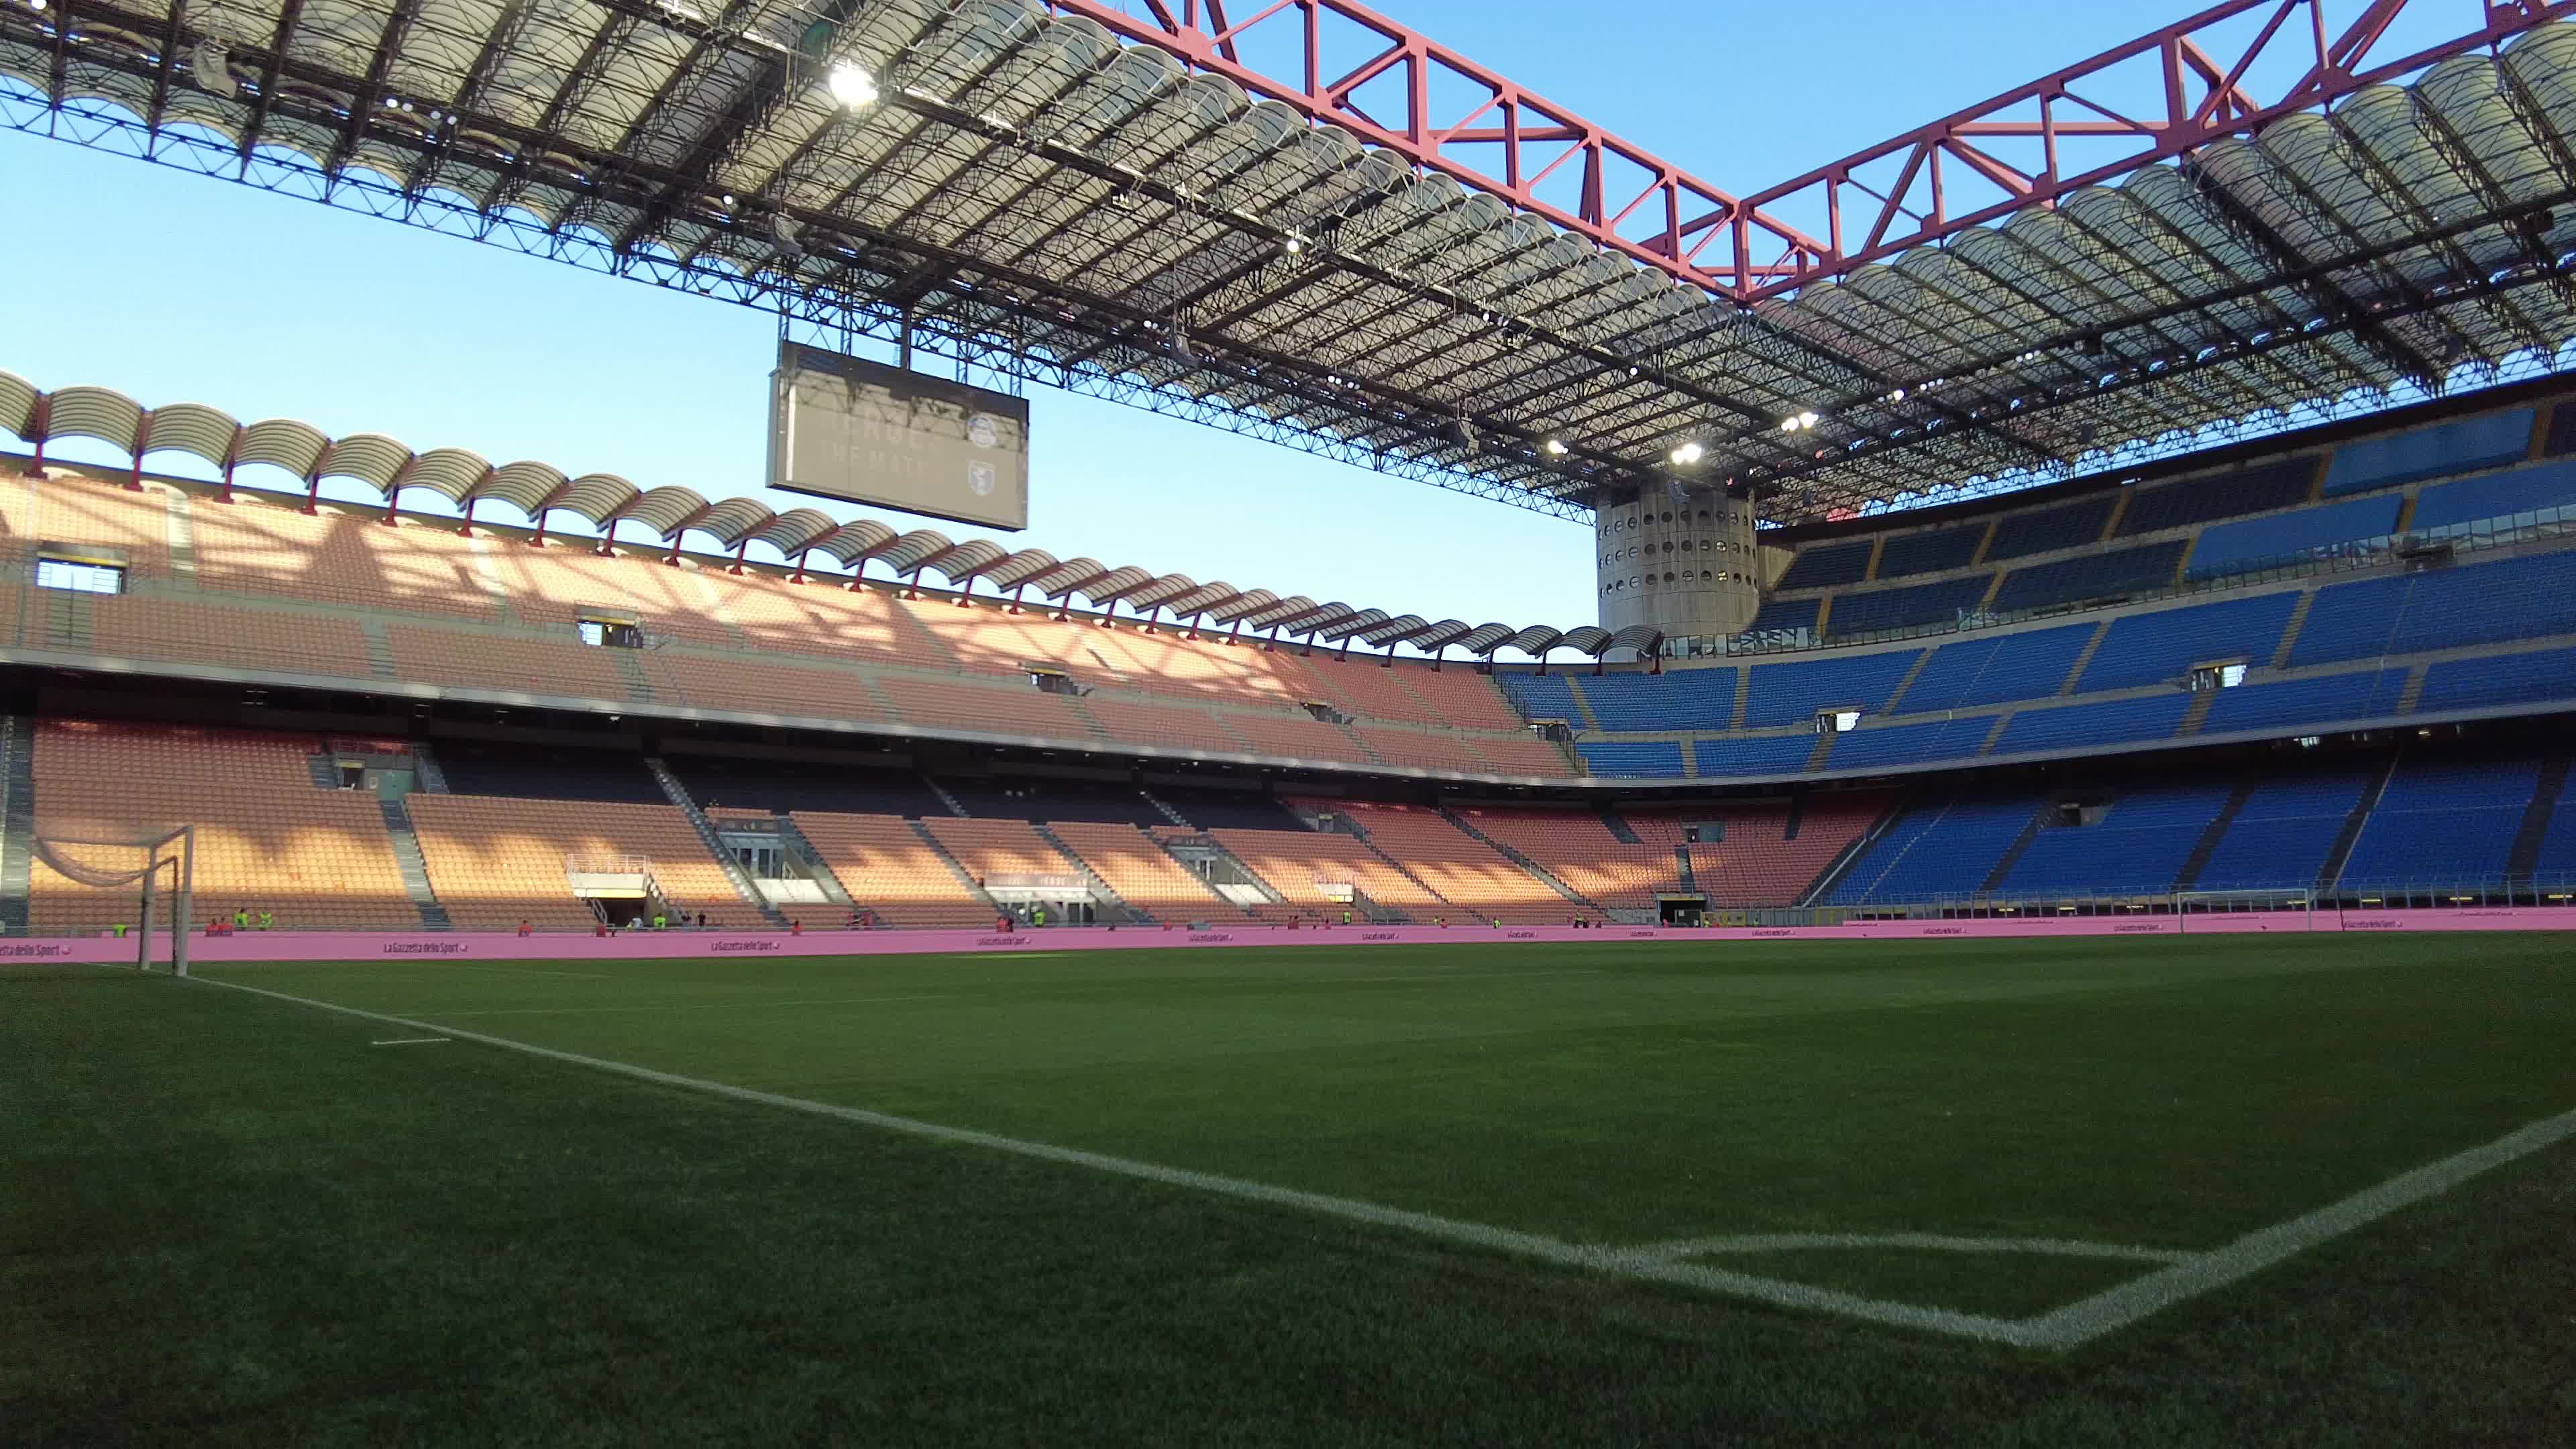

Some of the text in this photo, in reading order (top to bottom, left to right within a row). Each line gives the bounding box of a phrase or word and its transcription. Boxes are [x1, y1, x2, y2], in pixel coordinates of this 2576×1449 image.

[16, 944, 34, 956] dello
[35, 944, 59, 958] Sport
[384, 943, 458, 955] La Gazzetta dello Sport
[718, 941, 742, 951] Gazzetta
[757, 941, 772, 951] Sport
